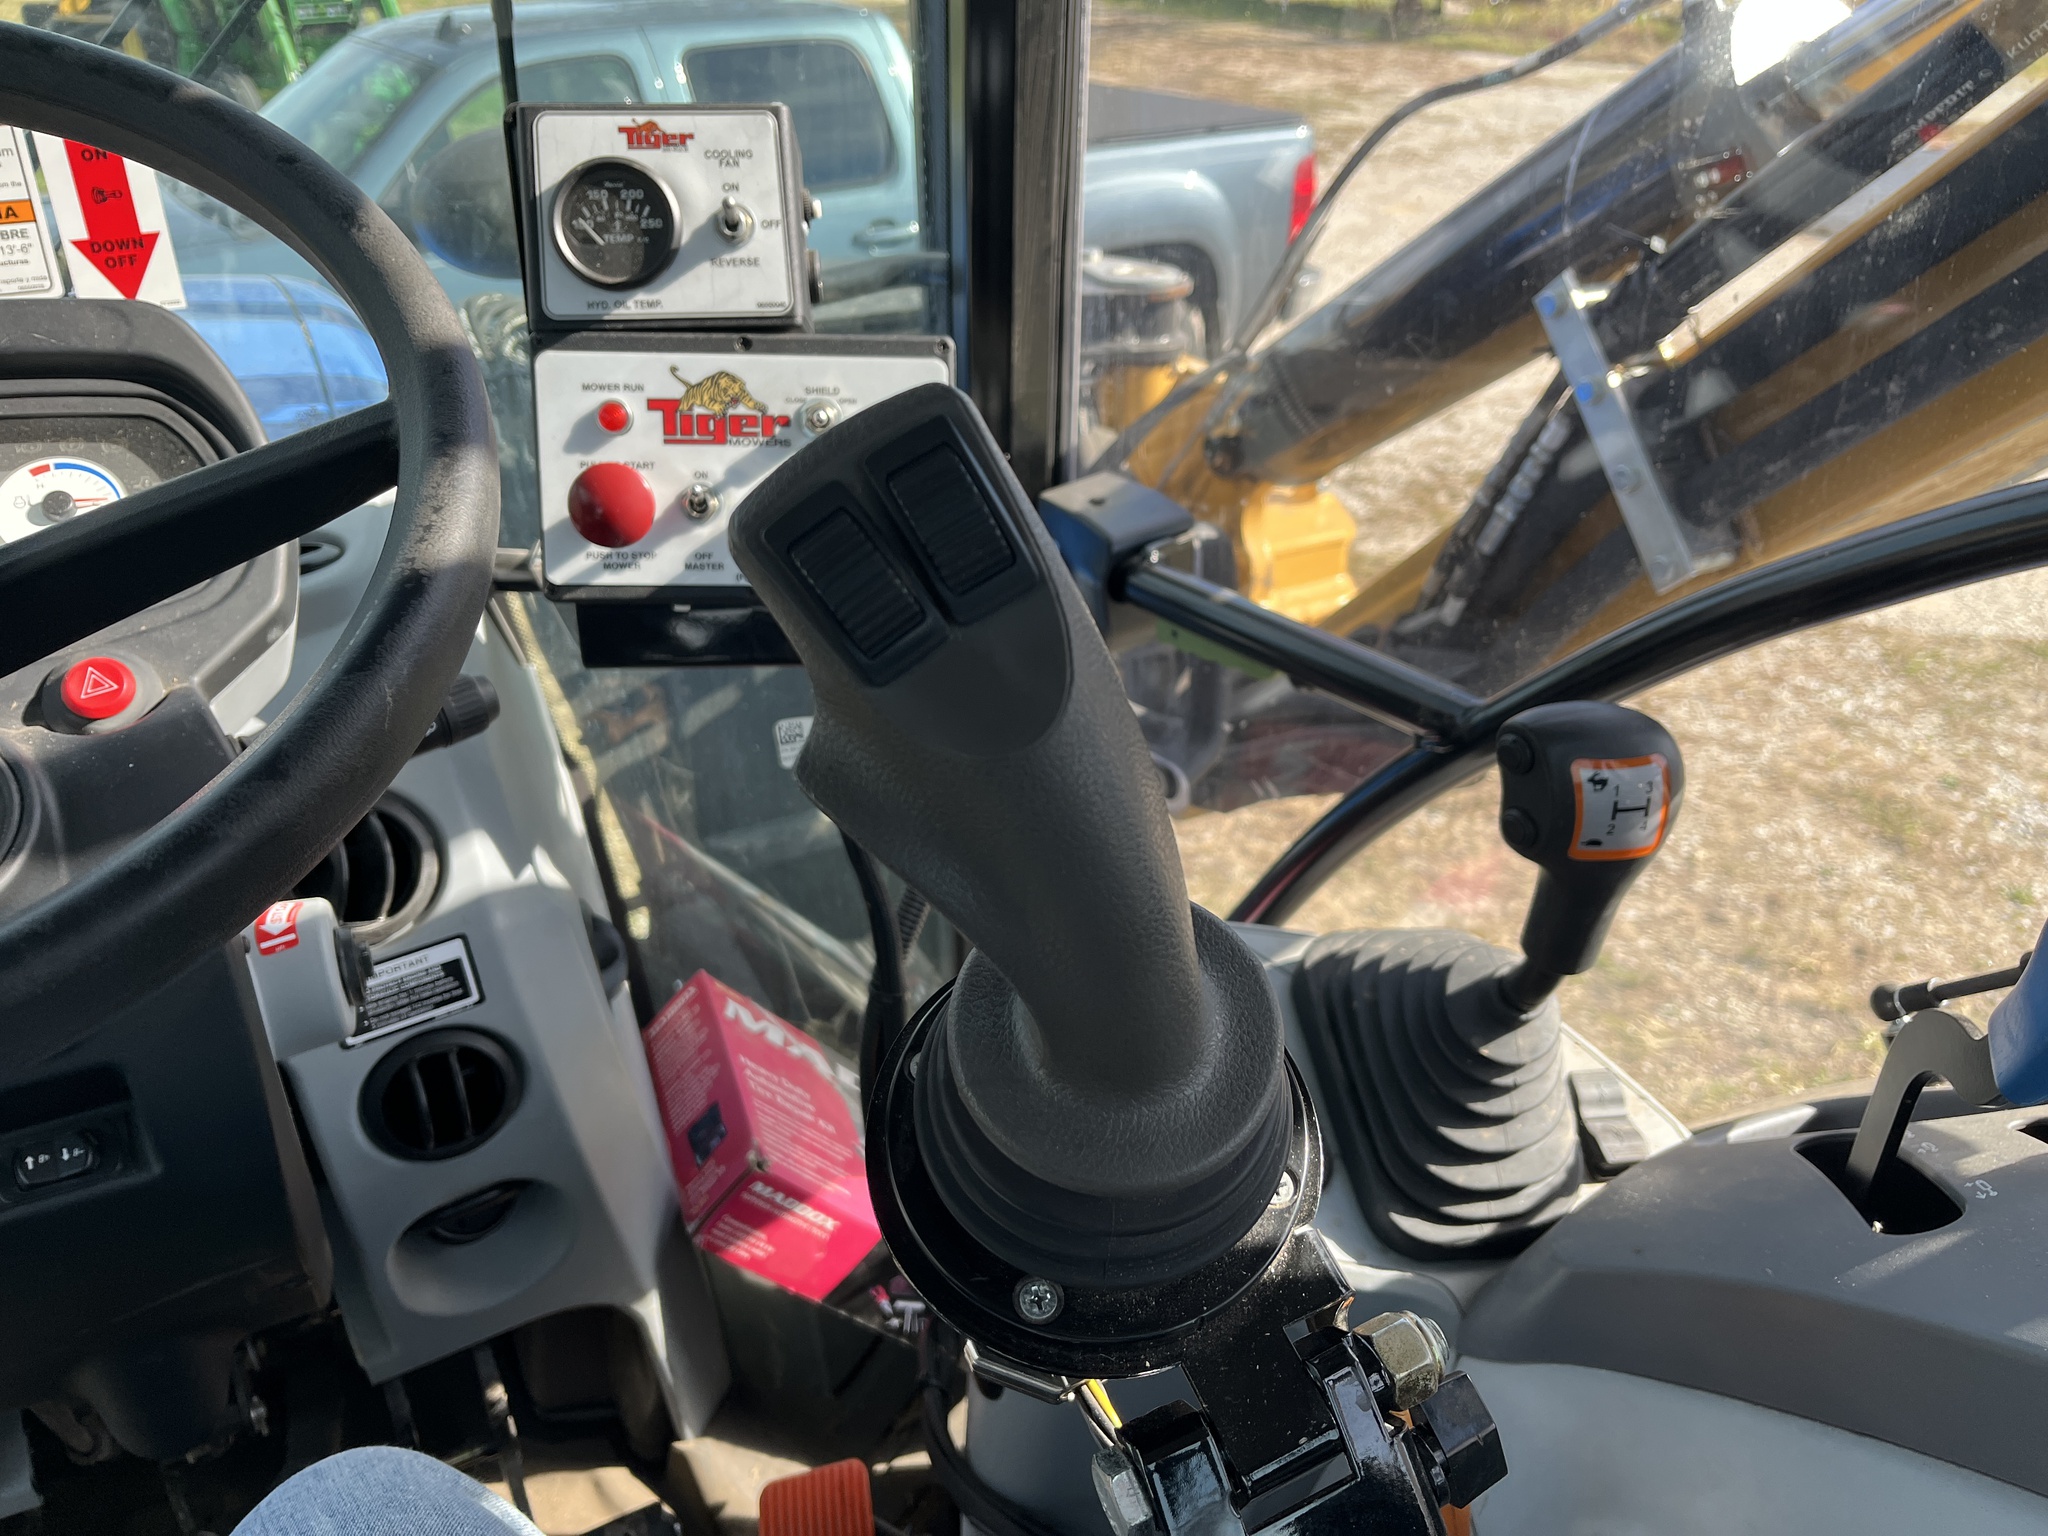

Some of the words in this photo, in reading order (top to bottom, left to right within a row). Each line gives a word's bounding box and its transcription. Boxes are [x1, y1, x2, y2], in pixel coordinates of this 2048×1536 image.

[618, 126, 695, 149] Tiger
[81, 149, 108, 162] ON
[704, 149, 753, 159] COOLING
[719, 159, 740, 168] FAN
[722, 182, 740, 192] ON
[586, 189, 609, 200] 150
[620, 189, 644, 200] 200
[640, 218, 663, 229] 250
[761, 219, 782, 229] OFF
[603, 233, 634, 244] TEMP
[90, 238, 144, 254] DOWN
[104, 255, 137, 269] OFF
[711, 257, 760, 267] REVERSE
[586, 300, 611, 310] HYD.
[614, 300, 629, 309] OIL
[635, 299, 664, 309] TEMP.
[582, 382, 621, 392] MOWER
[624, 382, 645, 392] RUN
[805, 386, 840, 396] SHIELD
[647, 398, 791, 445] Tiger
[728, 438, 792, 447] MOWERS
[694, 471, 709, 479] ON
[586, 551, 612, 560] PUSH
[615, 551, 629, 560] TO
[631, 551, 657, 560] STOP
[694, 552, 714, 560] OFF
[603, 562, 641, 570] MOWER
[684, 562, 725, 571] MASTER
[1606, 823, 1616, 836] 2
[366, 955, 430, 981] MPORTANT
